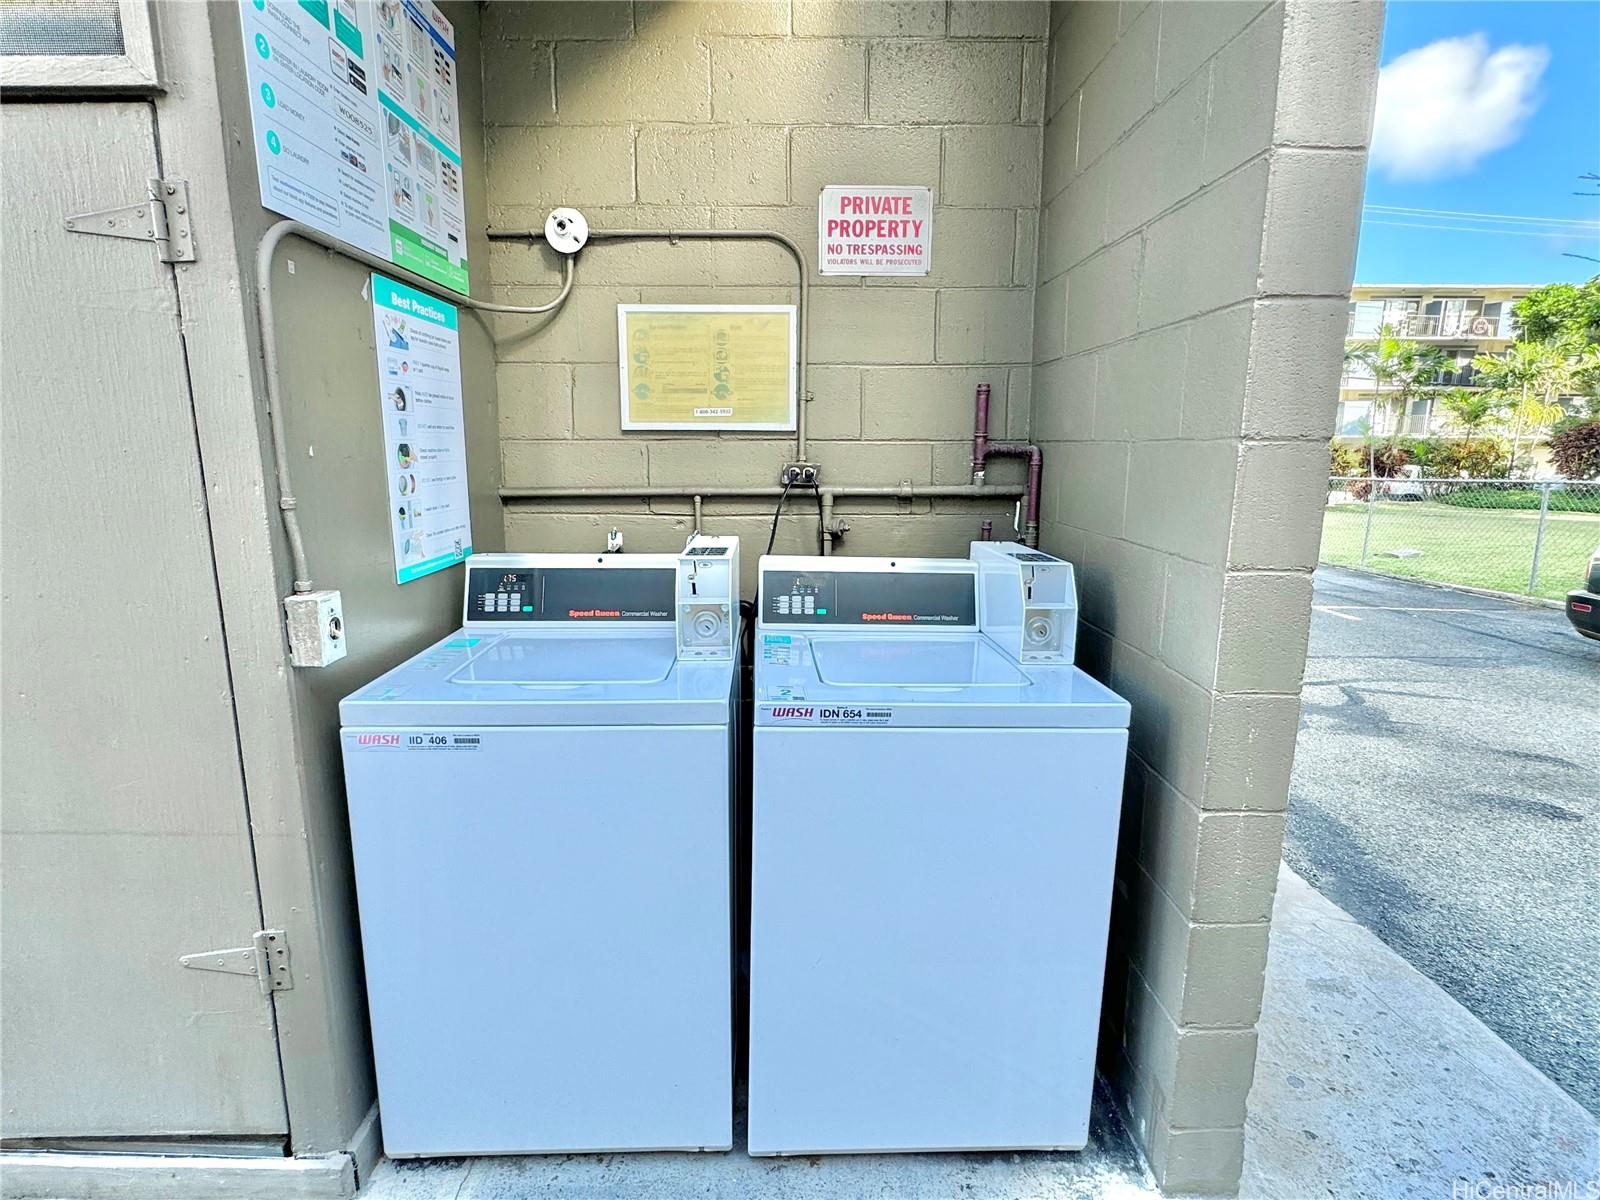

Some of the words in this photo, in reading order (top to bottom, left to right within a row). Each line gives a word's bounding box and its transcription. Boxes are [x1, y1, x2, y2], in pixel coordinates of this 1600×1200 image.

[840, 196, 912, 215] PRIVATE
[827, 219, 923, 238] PROPERTY
[827, 244, 843, 255] NO
[846, 244, 923, 255] TRESPASSING
[390, 290, 411, 311] Best
[411, 299, 446, 323] Practices
[568, 609, 594, 618] Speed
[595, 609, 620, 617] Queen
[862, 613, 887, 621] Speed
[772, 707, 814, 718] WASH
[820, 709, 840, 718] IDN
[842, 709, 862, 718] 654
[358, 734, 400, 745] WASH
[408, 736, 423, 745] IID
[428, 736, 447, 745] 406
